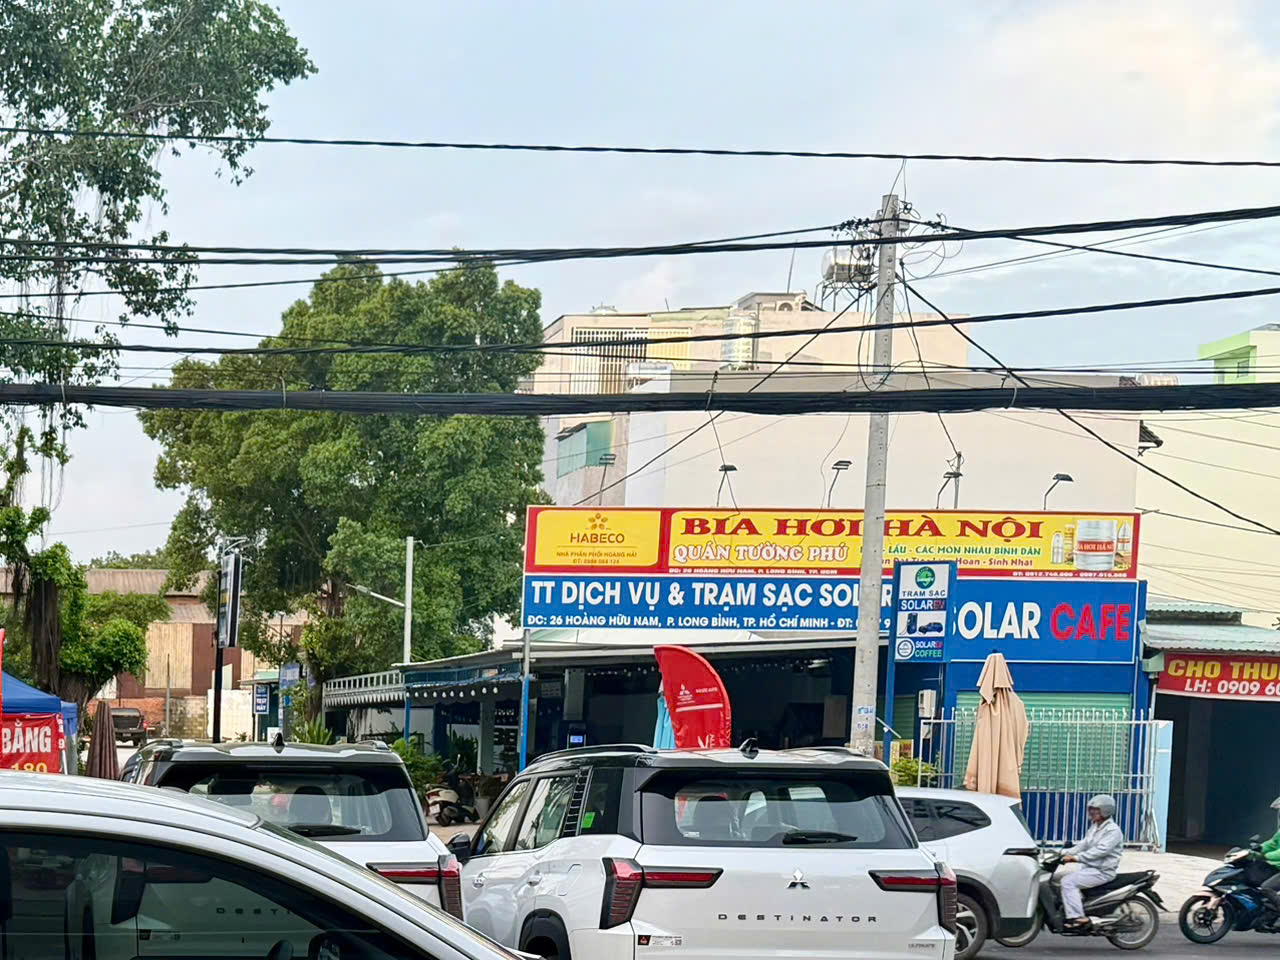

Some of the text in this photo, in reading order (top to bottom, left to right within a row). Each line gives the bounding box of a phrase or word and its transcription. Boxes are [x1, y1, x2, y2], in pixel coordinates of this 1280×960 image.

[570, 533, 625, 543] HABECO
[680, 517, 762, 536] BIA
[884, 515, 945, 537] HÀ
[957, 516, 1044, 542] NỘI
[673, 541, 731, 563] QUÁN
[807, 543, 849, 561] PHÚ
[532, 580, 893, 612] TT DỊCH VỤ & TRẠM SẠC SOLR
[527, 615, 547, 625] ĐC:
[550, 615, 562, 626] 26
[565, 612, 606, 626] HOÀNG
[679, 617, 708, 627] LONG
[760, 613, 777, 628] HỒ
[779, 614, 799, 628] CHÍ
[800, 618, 828, 628] MINH
[1051, 602, 1131, 642] CAFE
[1168, 659, 1280, 680] CHO THU
[1184, 679, 1212, 693] LH:
[1217, 680, 1260, 695] 0909
[718, 913, 877, 923] DESTINATOR
